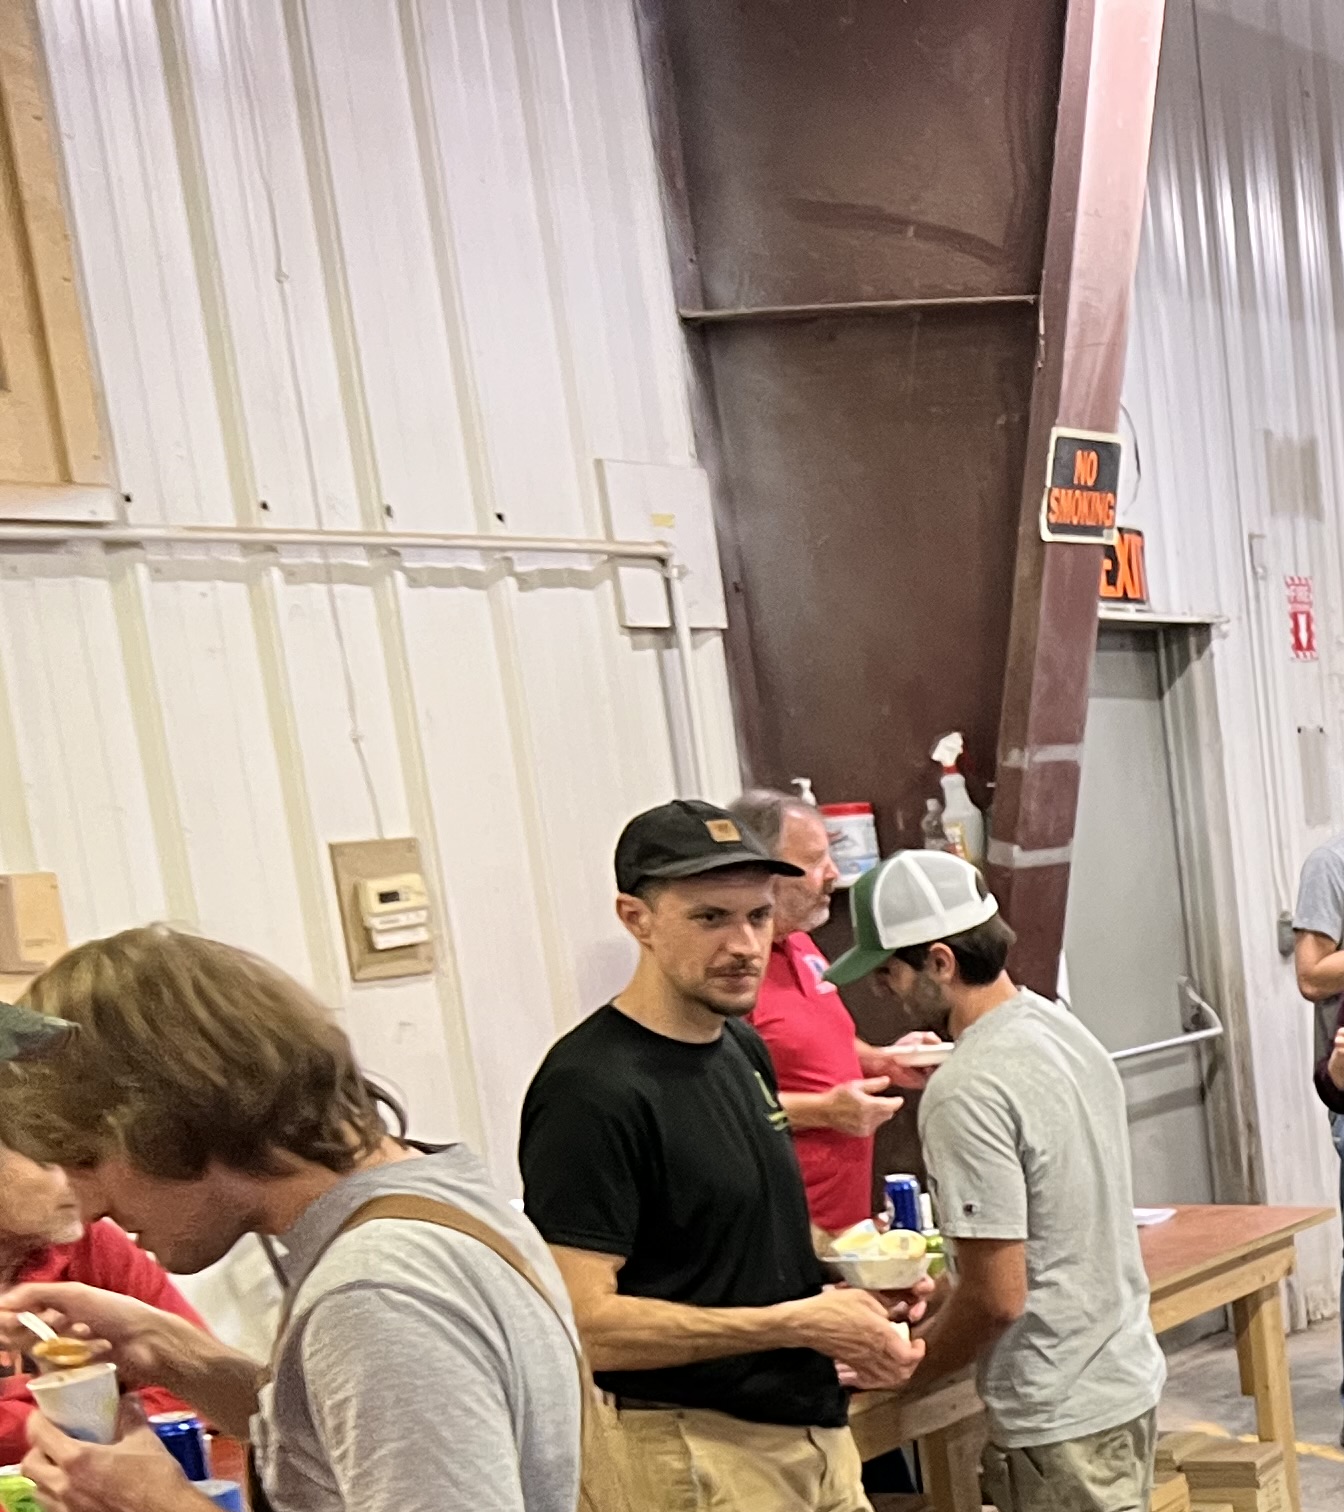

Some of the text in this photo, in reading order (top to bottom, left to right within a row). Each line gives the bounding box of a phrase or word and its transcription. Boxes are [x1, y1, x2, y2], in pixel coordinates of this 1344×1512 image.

[1073, 449, 1098, 487] NO
[1048, 486, 1116, 527] SMOKING
[1099, 533, 1147, 598] EXIT
